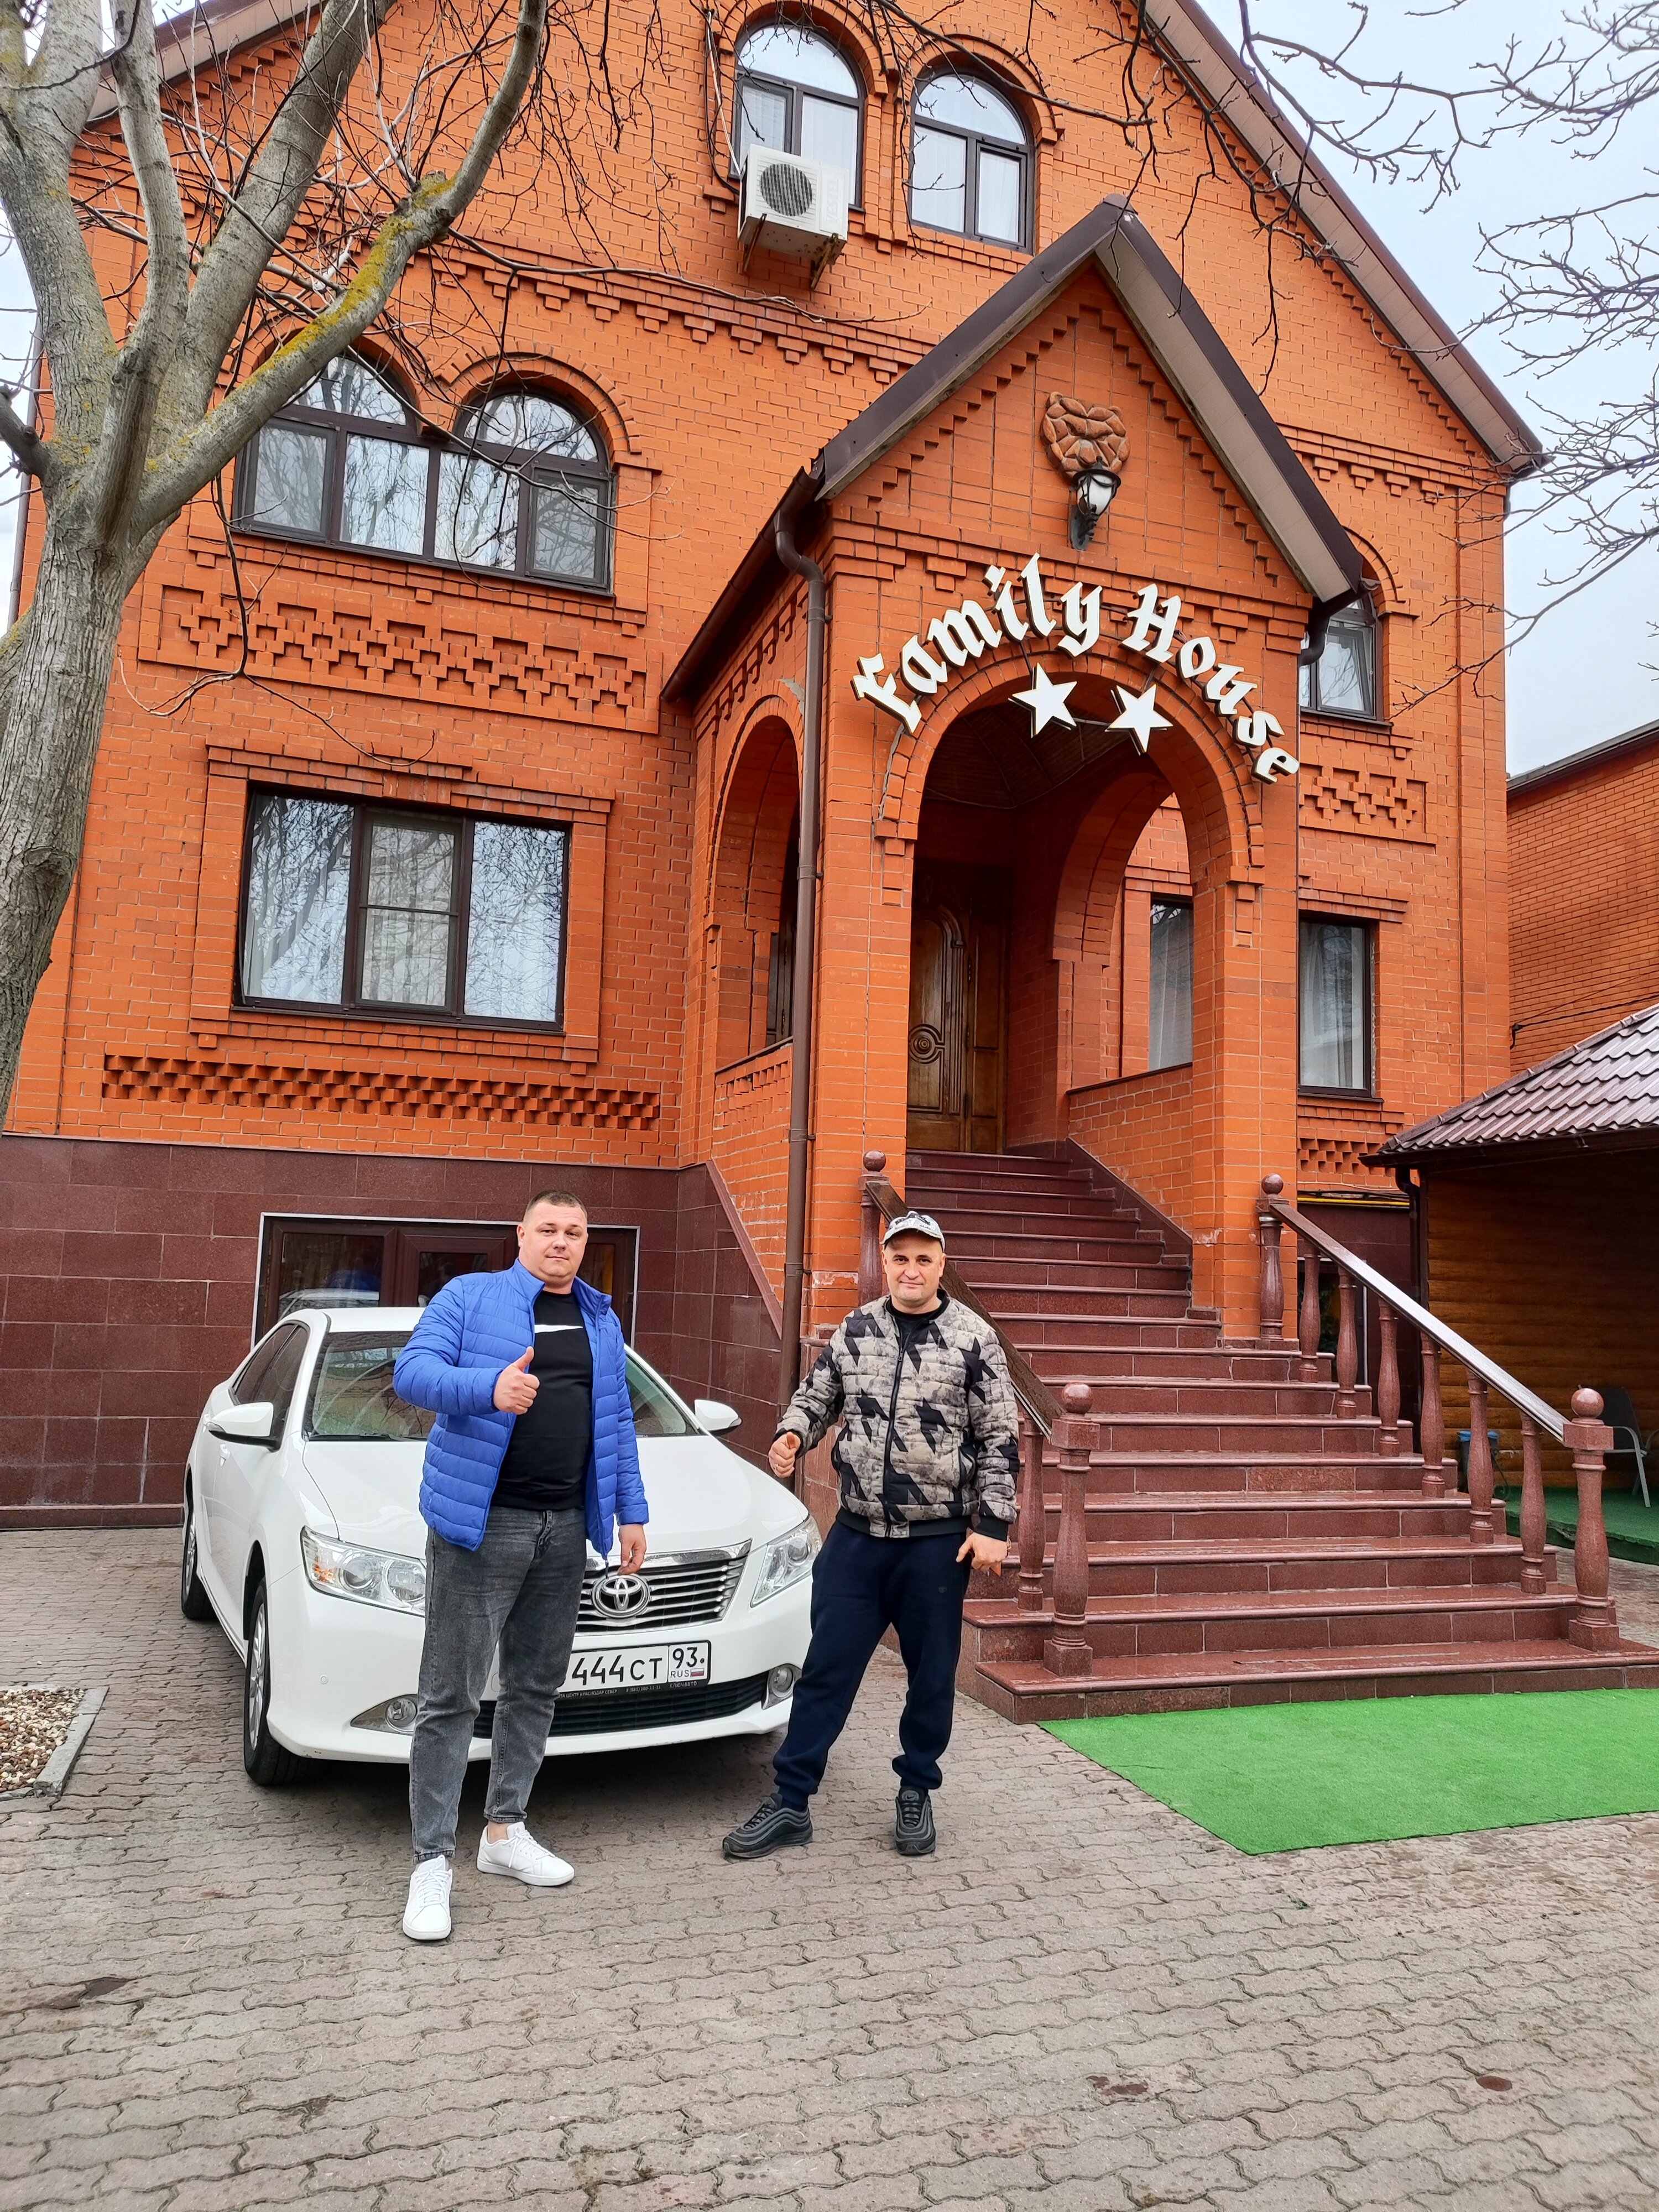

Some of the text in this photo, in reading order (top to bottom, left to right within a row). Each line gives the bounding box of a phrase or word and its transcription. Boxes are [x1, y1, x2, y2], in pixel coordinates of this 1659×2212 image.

[853, 552, 1300, 783] Family House
[672, 1647, 697, 1669] 93
[670, 1670, 690, 1679] RUS
